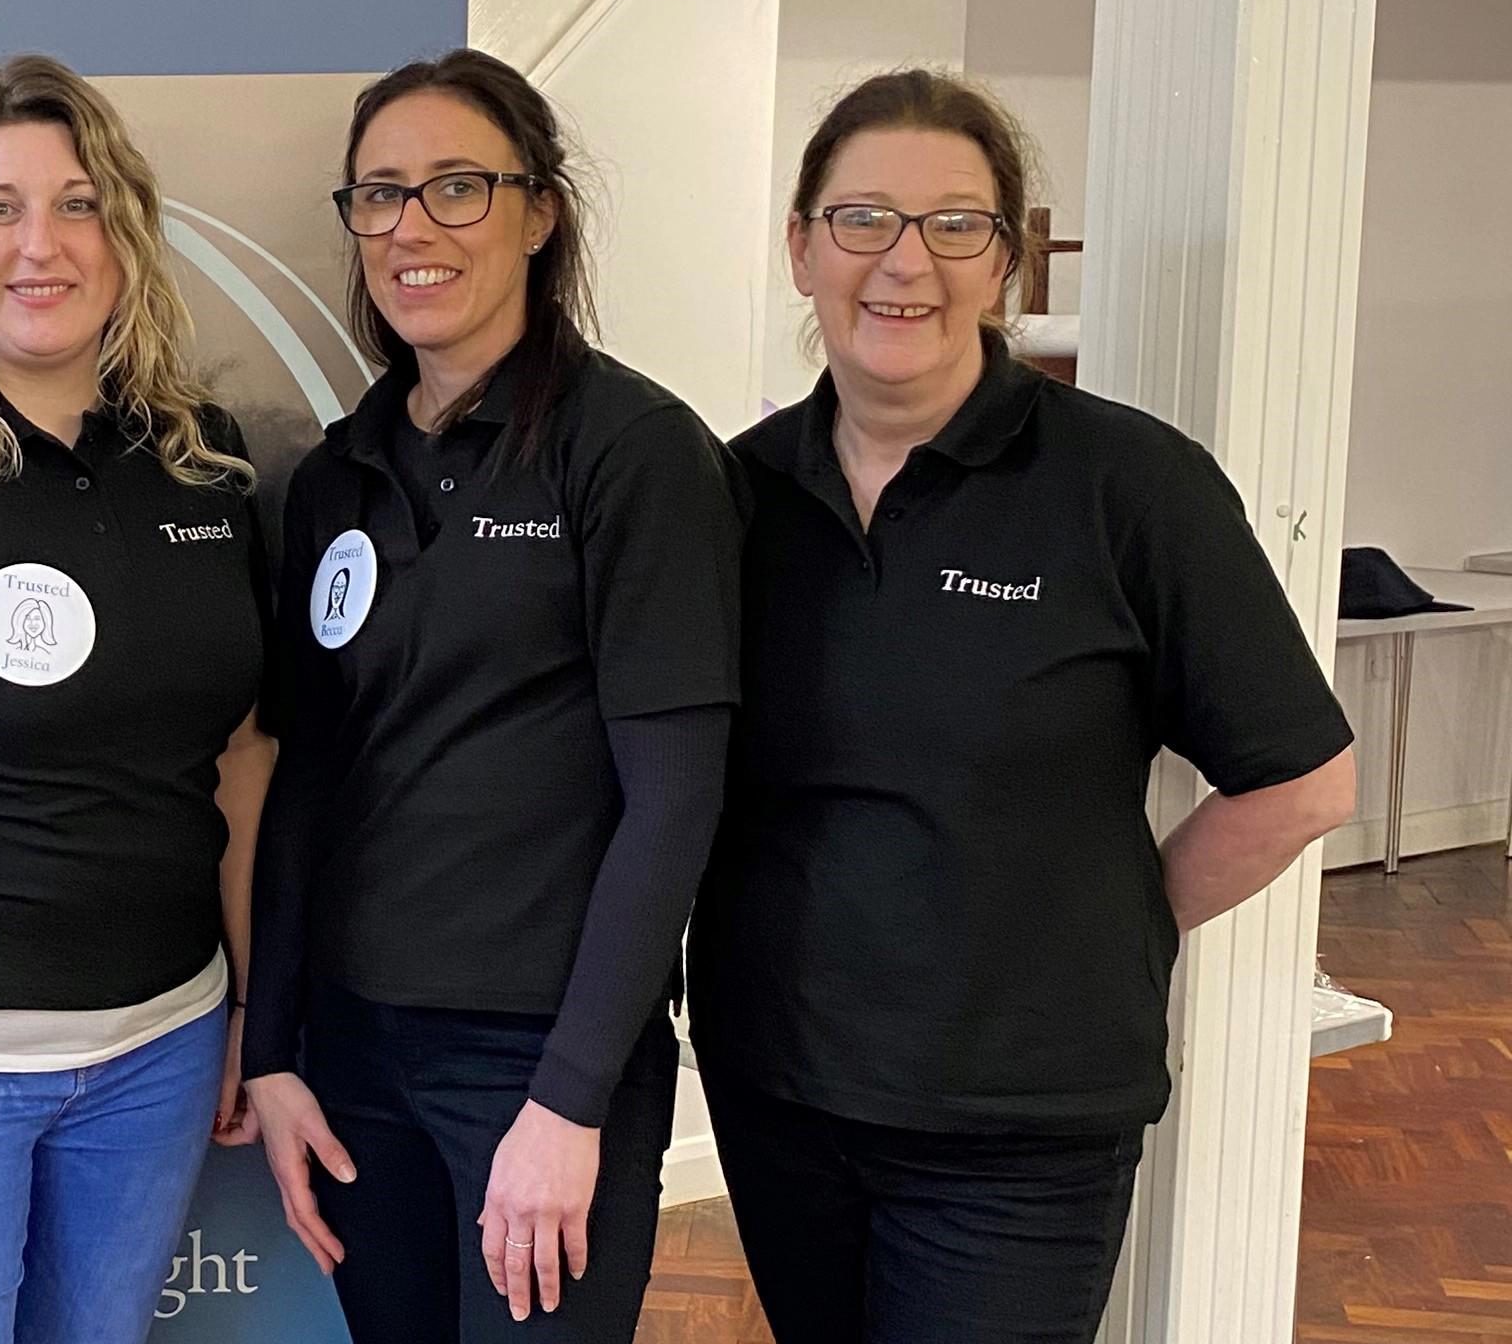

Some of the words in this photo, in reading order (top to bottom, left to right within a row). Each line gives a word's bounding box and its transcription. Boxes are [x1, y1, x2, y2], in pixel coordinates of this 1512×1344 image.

[159, 518, 234, 543] Trusted
[472, 514, 561, 538] Trusted
[328, 541, 365, 562] Trusted
[4, 573, 71, 598] Trusted
[940, 569, 1041, 601] Trusted
[1, 653, 50, 673] Jessica
